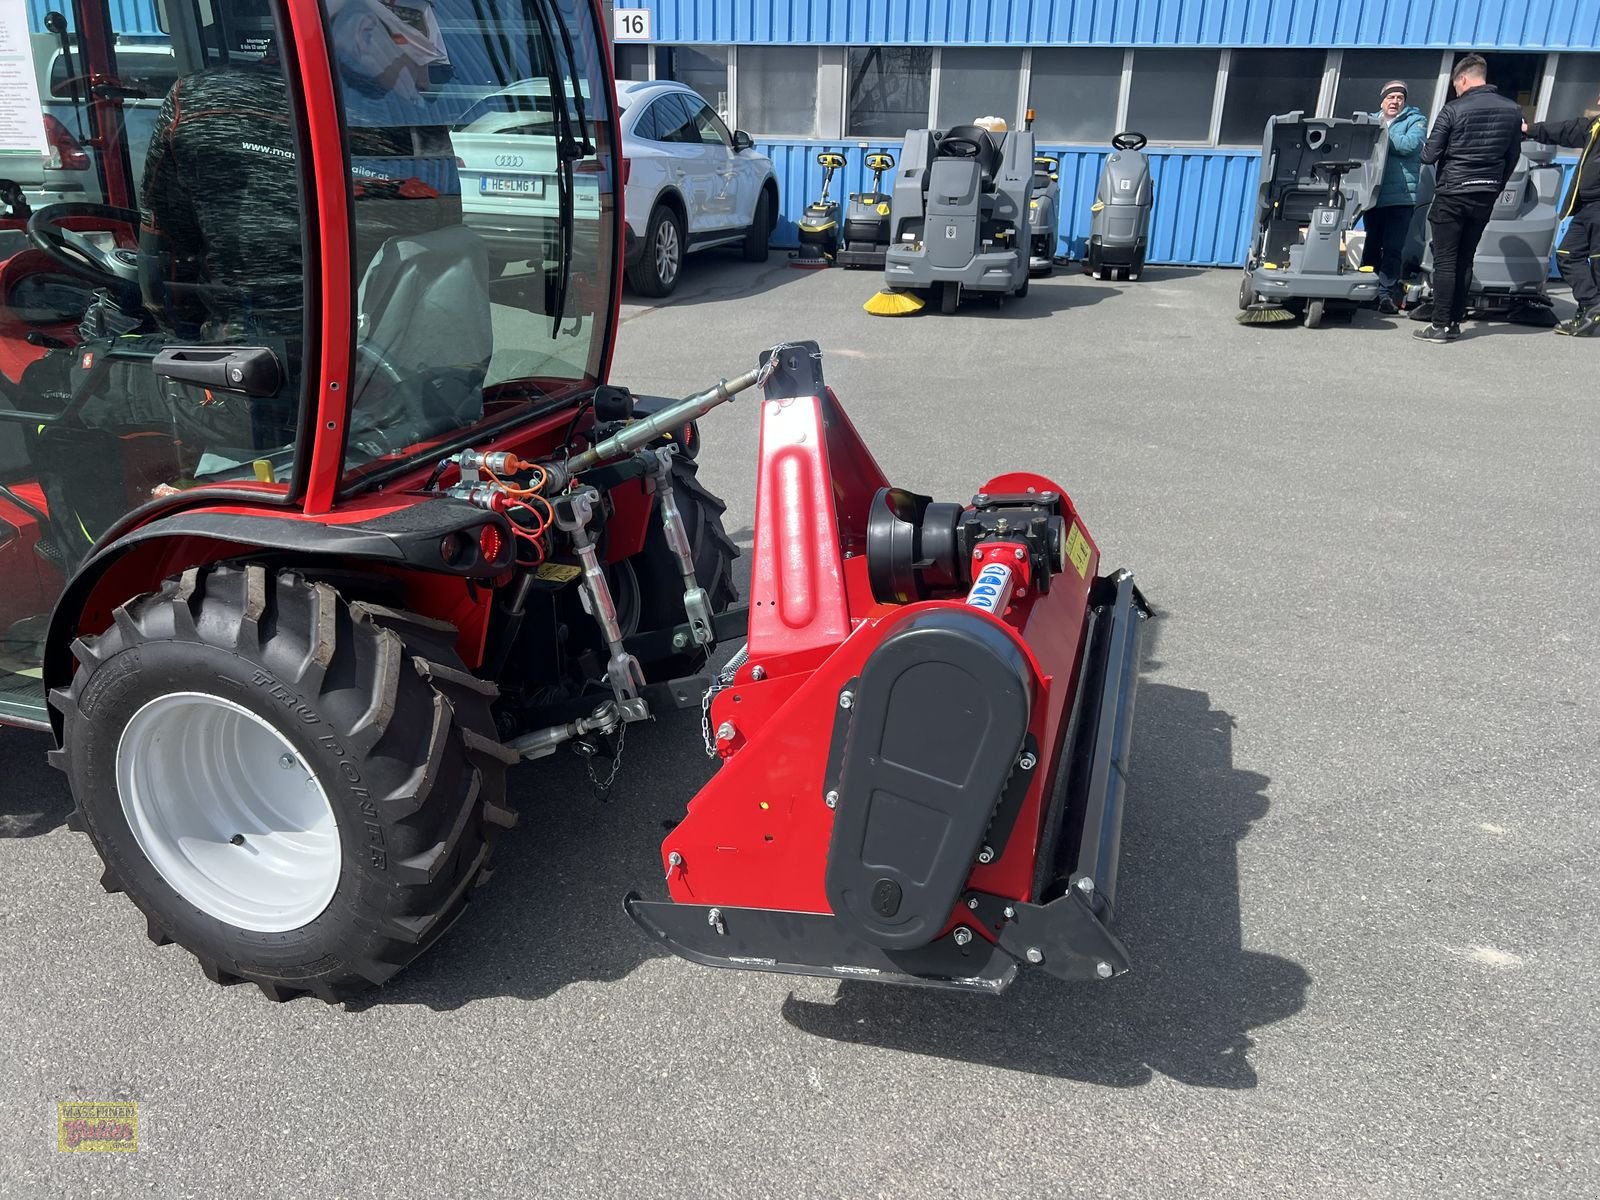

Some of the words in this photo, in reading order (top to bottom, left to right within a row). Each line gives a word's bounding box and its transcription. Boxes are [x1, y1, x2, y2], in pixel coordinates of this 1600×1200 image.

[622, 15, 644, 34] 16
[492, 179, 504, 191] HE
[510, 180, 529, 192] LMG
